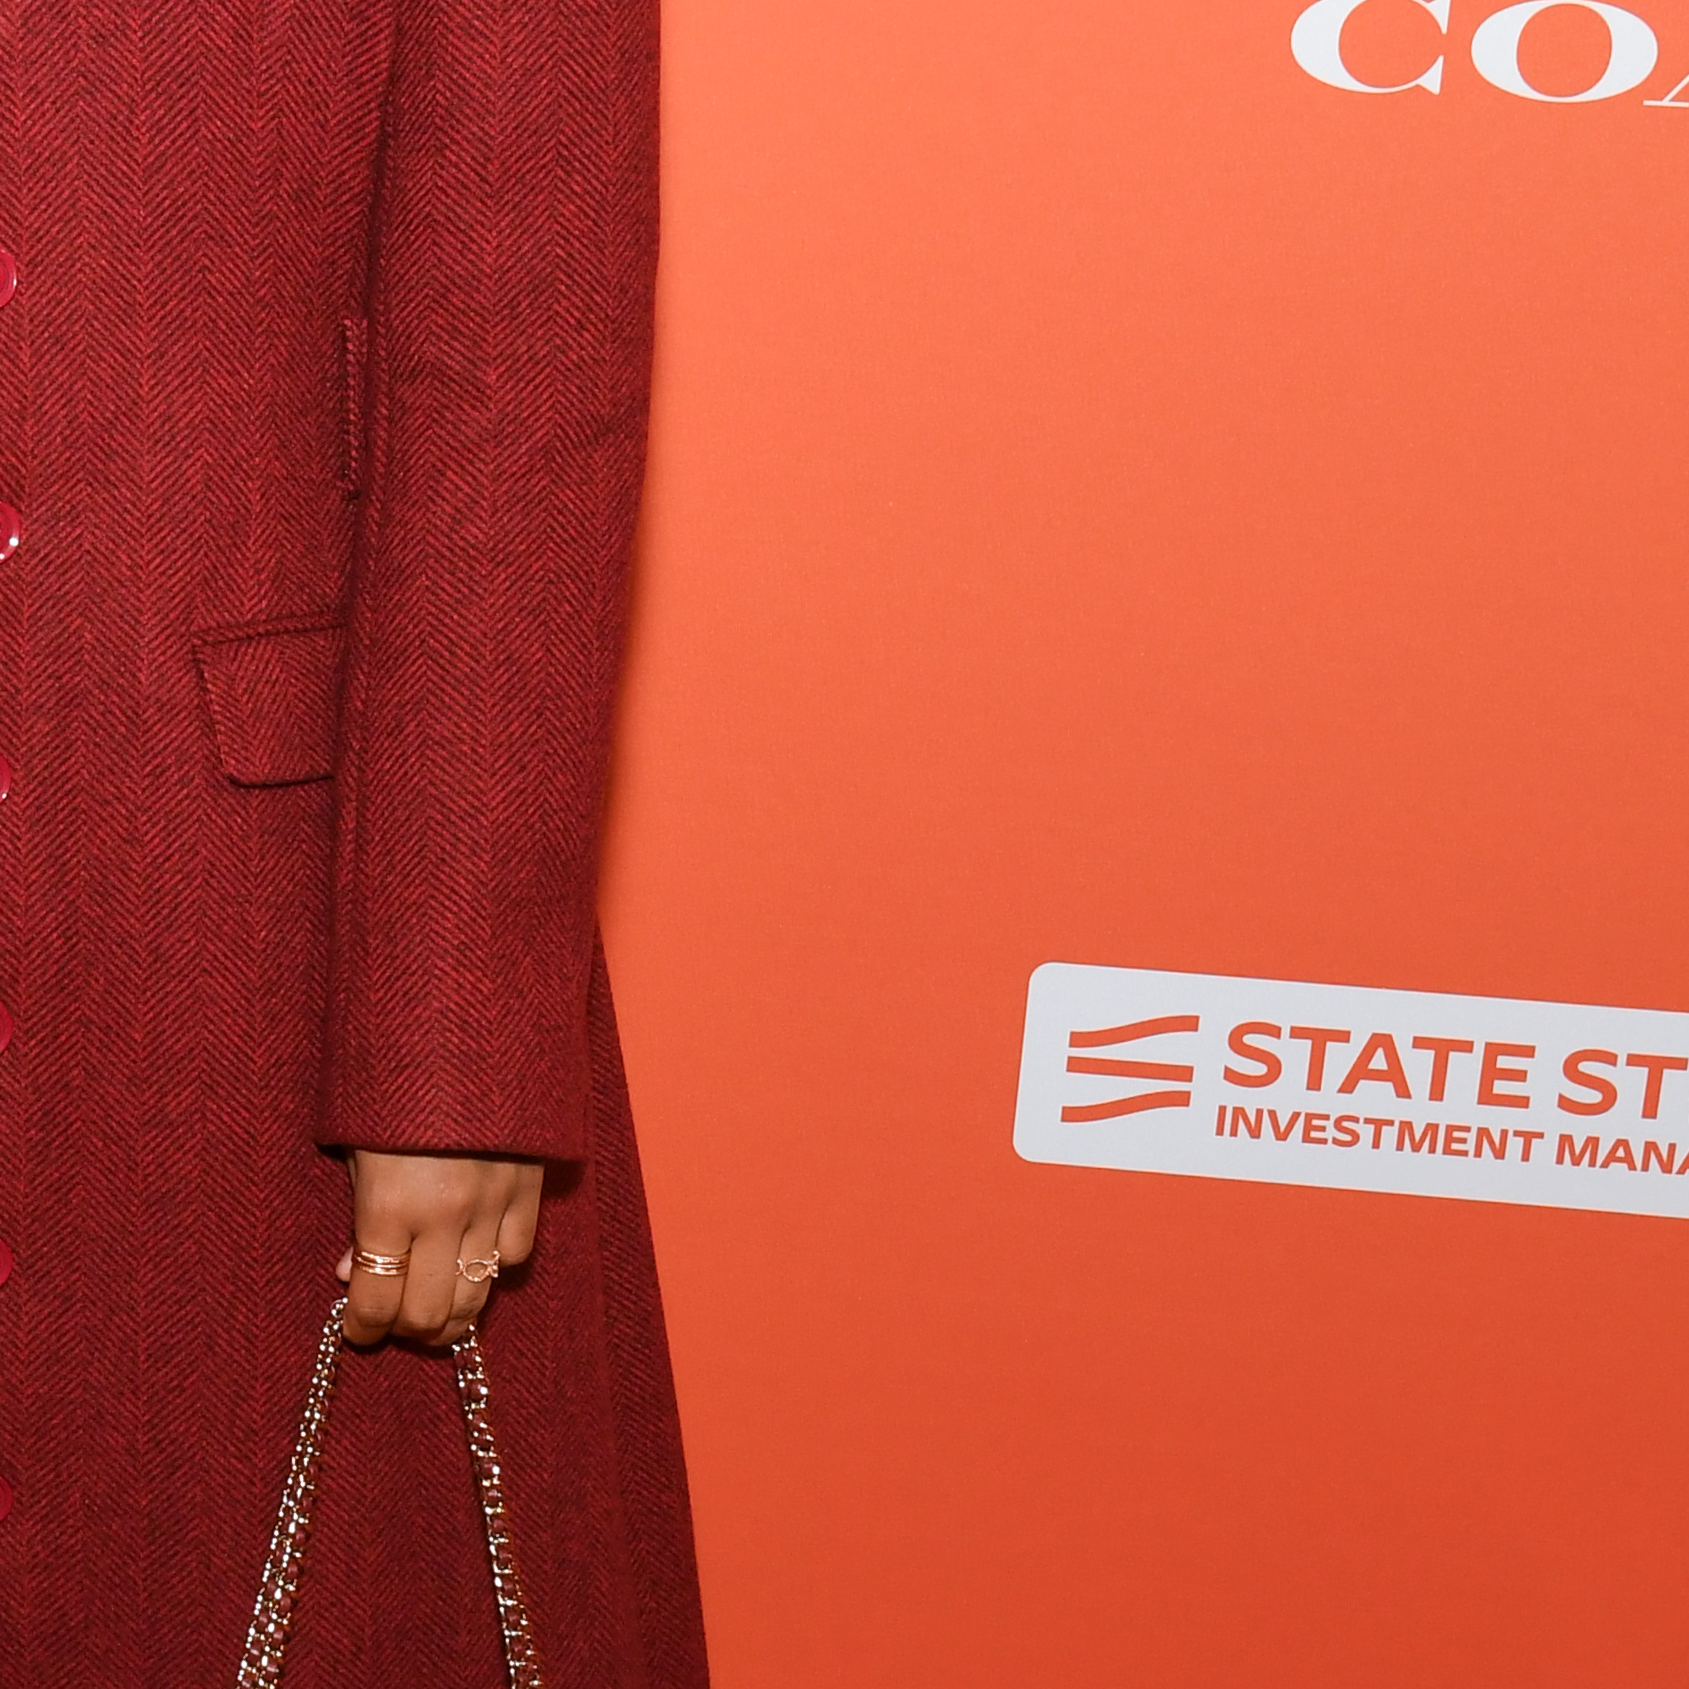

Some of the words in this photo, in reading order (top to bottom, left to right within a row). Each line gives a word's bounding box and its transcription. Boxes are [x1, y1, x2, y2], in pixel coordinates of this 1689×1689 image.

[1223, 1021, 1536, 1109] STATE
[1557, 1049, 1688, 1120] ST
[1215, 1105, 1544, 1162] INVESTMENT
